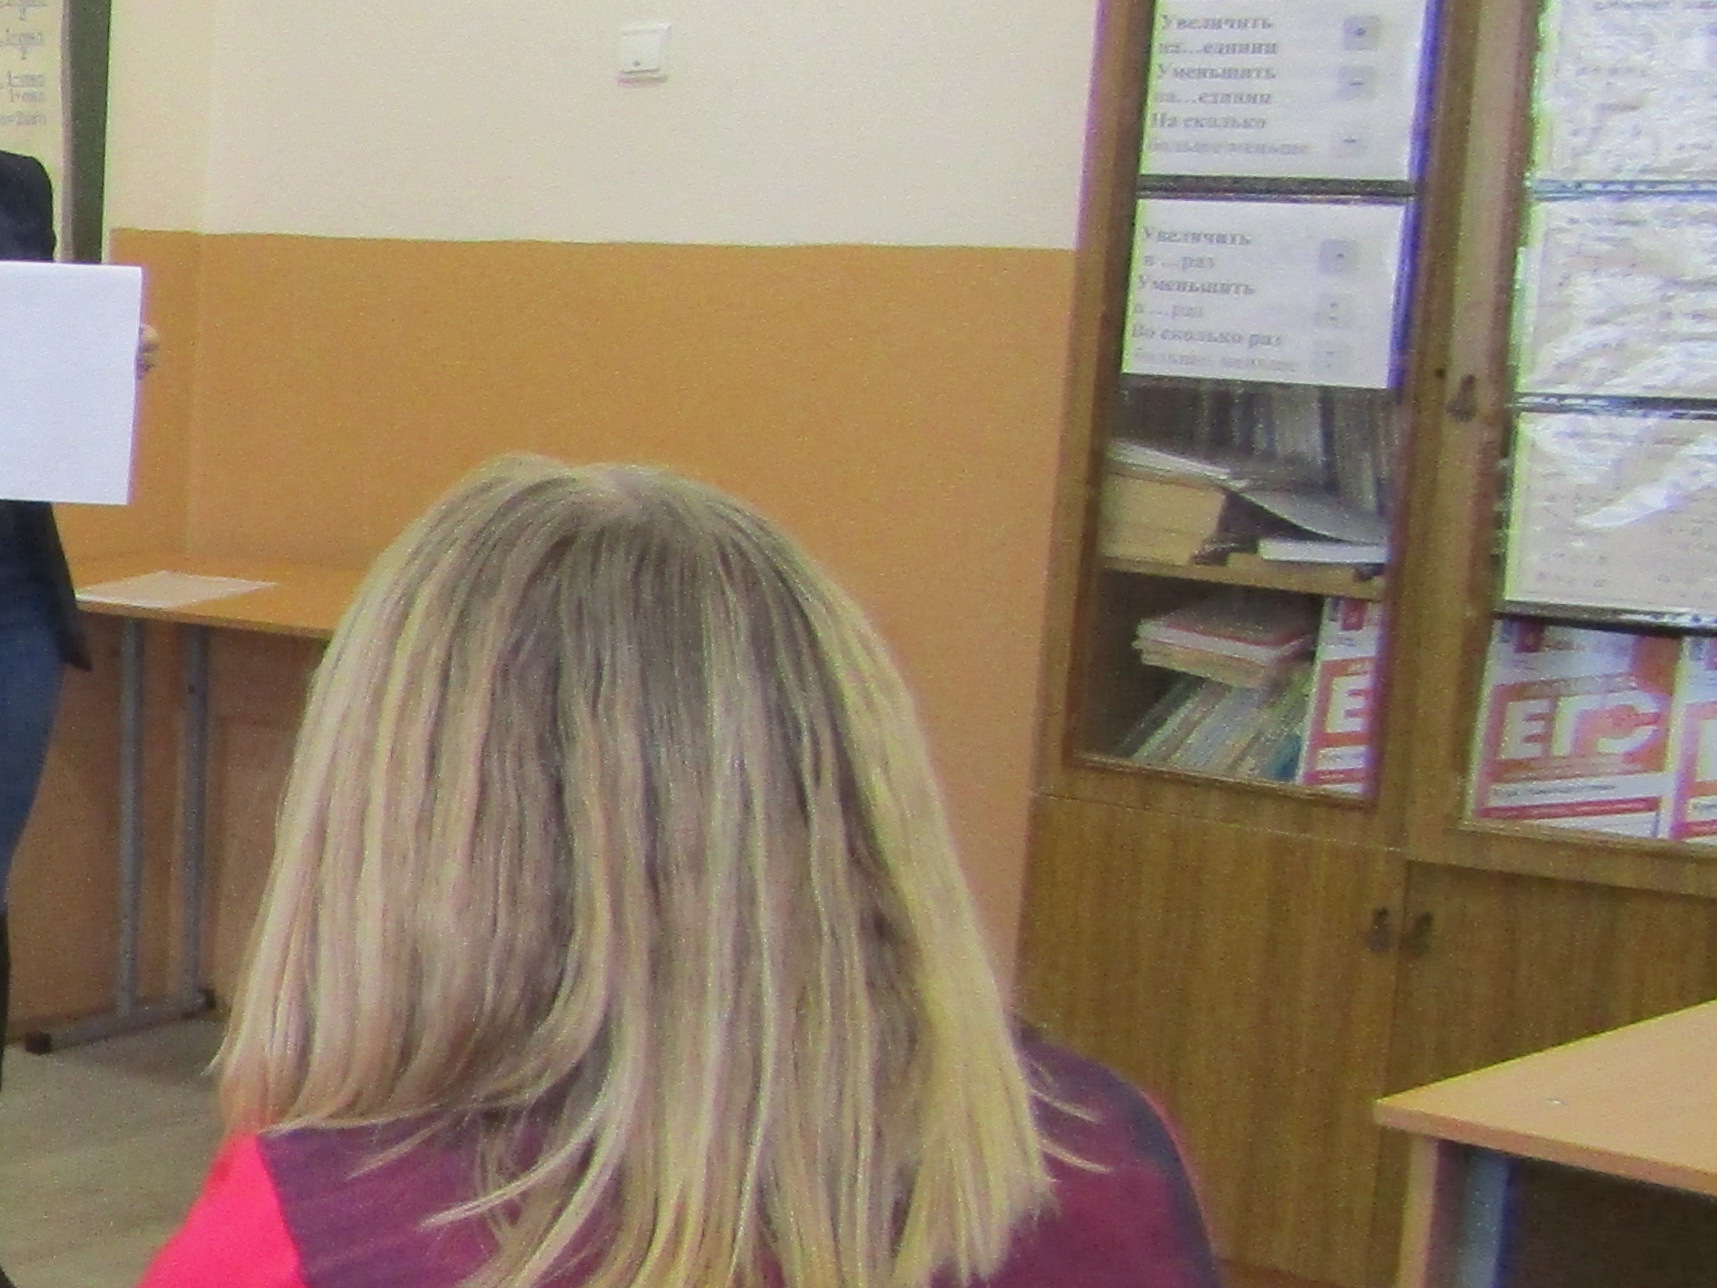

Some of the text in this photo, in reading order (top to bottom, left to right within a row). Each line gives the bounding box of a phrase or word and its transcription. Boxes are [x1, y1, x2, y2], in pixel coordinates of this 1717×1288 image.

[1160, 14, 1274, 31] Увеличить
[1157, 63, 1277, 80] Уменьшить
[1151, 112, 1177, 129] На
[1142, 225, 1252, 246] Увеличить
[1137, 274, 1256, 296] Уменьшить
[1160, 327, 1244, 345] сколько
[1247, 332, 1283, 349] раз
[1497, 690, 1660, 760] ЕГЭ
